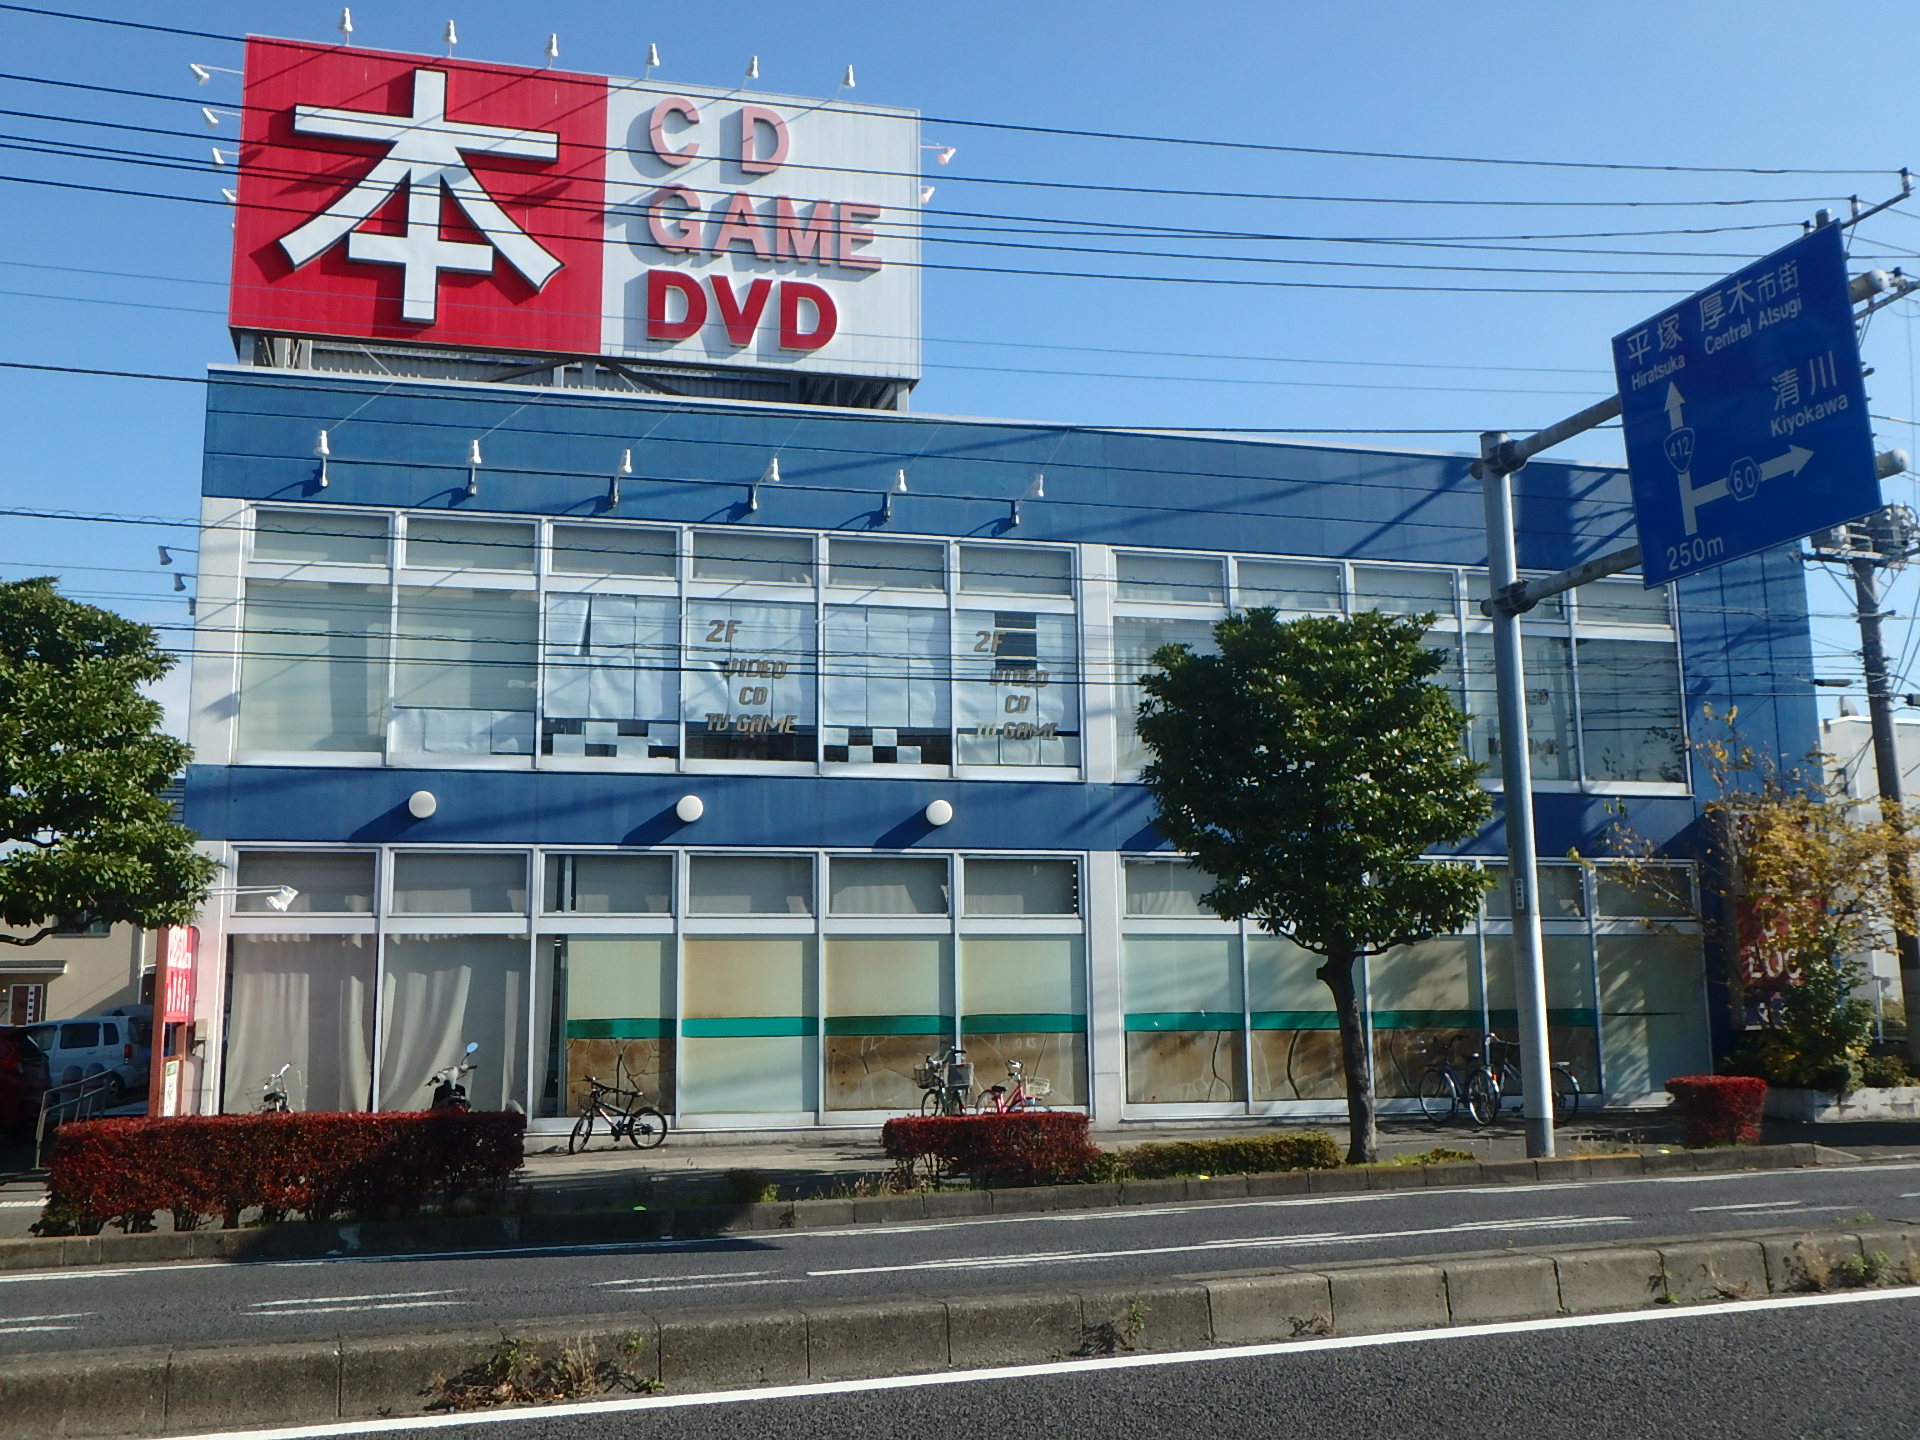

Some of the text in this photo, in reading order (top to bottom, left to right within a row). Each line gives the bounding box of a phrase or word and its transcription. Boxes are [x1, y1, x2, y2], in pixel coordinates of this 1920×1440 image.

[279, 68, 565, 325] 本
[648, 183, 882, 271] GAME
[646, 268, 838, 351] DVD
[1627, 313, 1683, 365] 平塚
[1632, 295, 1802, 391] Hiratsuka Central Atsugi
[1771, 351, 1837, 412] 清川
[1771, 393, 1849, 437] Kiyokawa
[1670, 435, 1692, 458] 412
[1733, 469, 1756, 489] 60
[1666, 534, 1725, 572] 250m
[706, 619, 742, 642] 2F
[973, 630, 1006, 653] 2F
[722, 658, 788, 679] VIDEO
[738, 686, 768, 706] CD
[1004, 694, 1032, 714] CD
[736, 713, 798, 734] GAME
[1003, 721, 1059, 741] GAME
